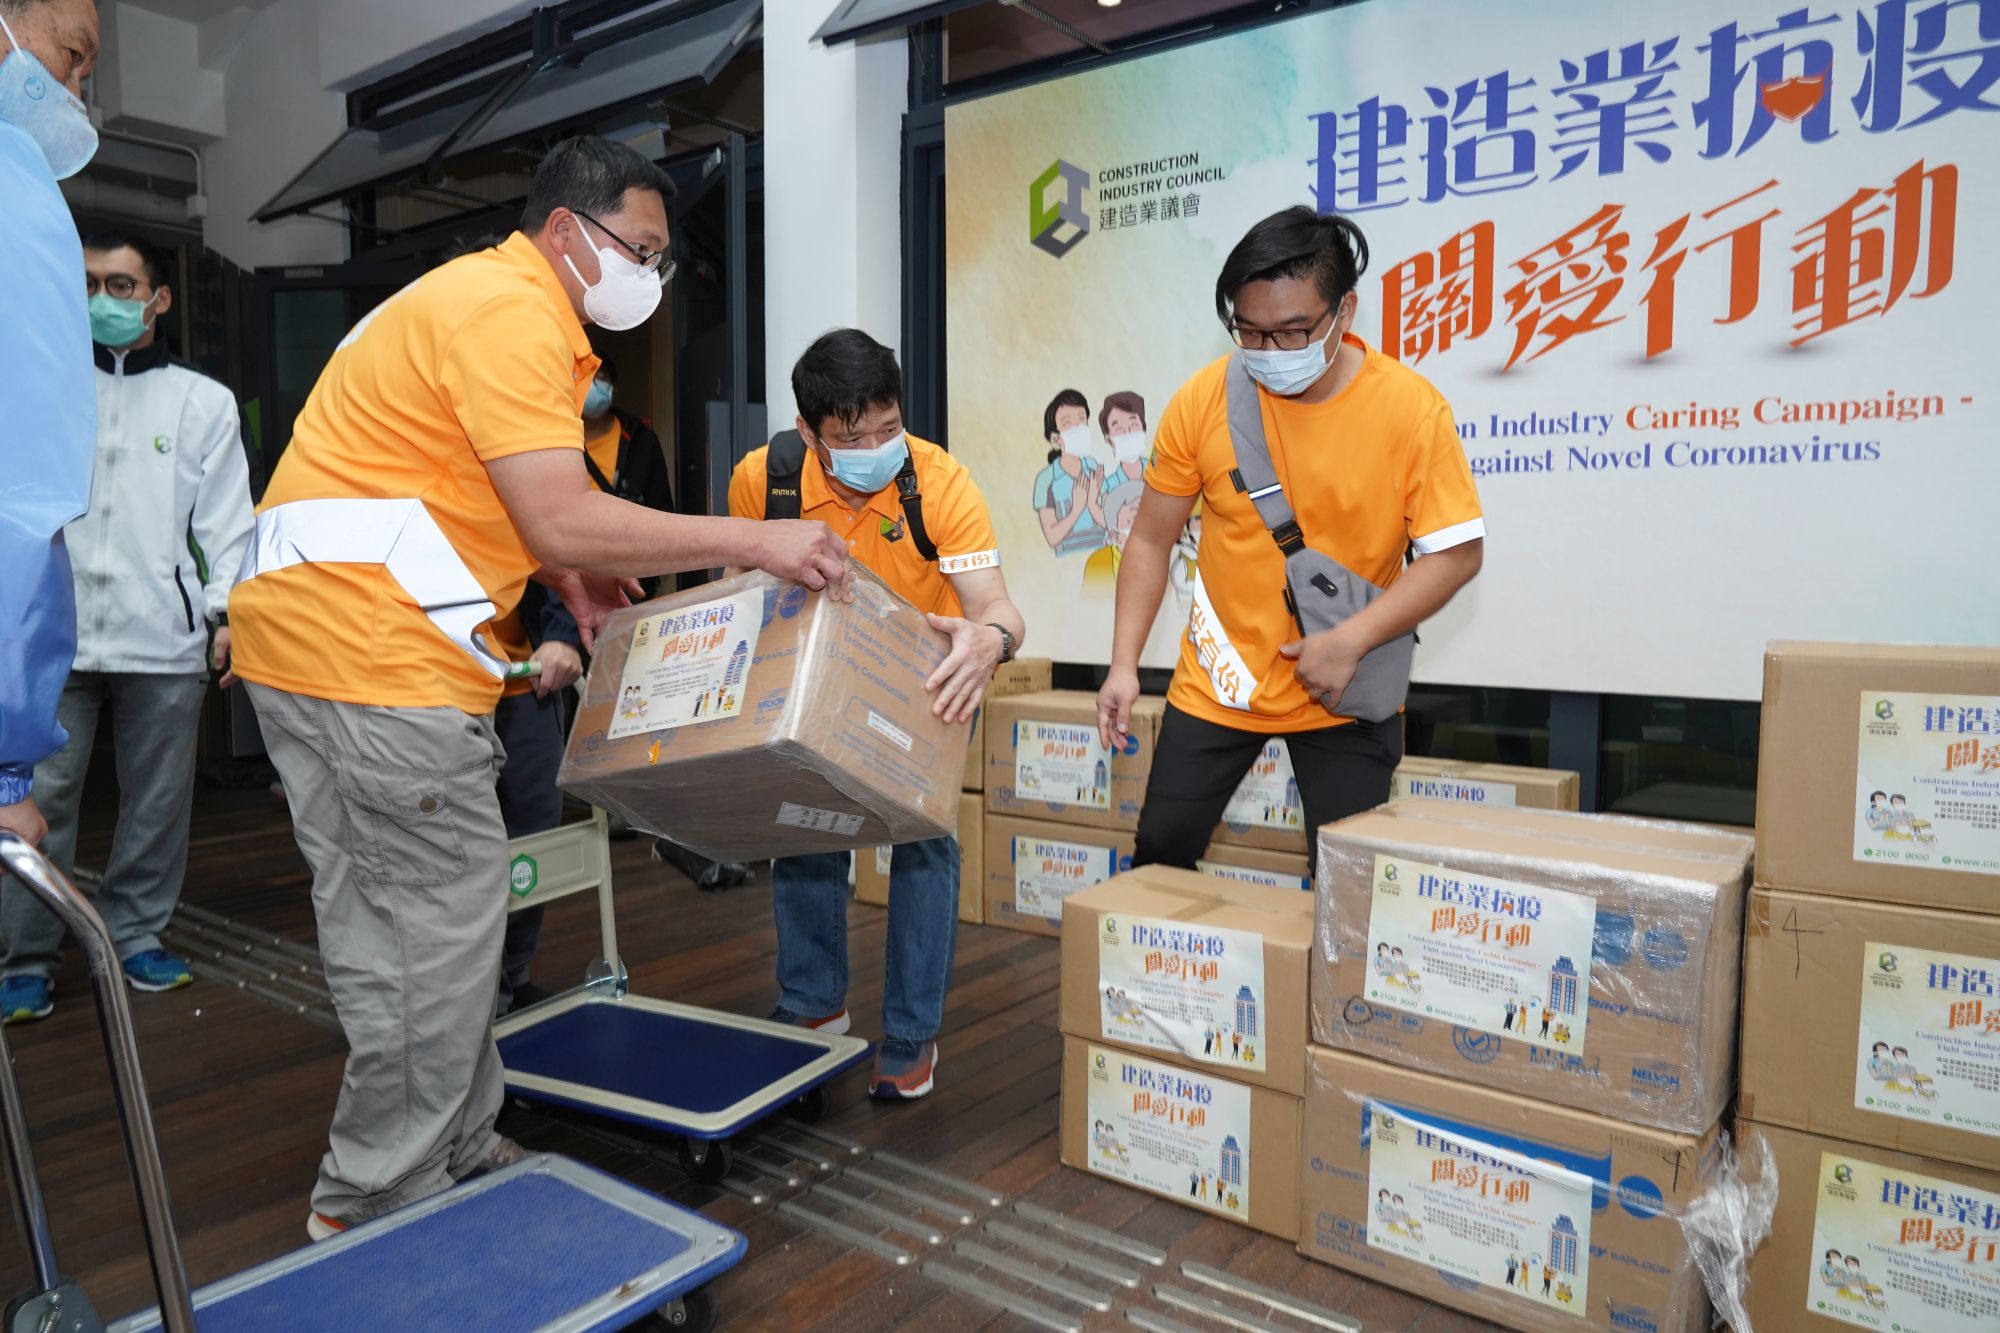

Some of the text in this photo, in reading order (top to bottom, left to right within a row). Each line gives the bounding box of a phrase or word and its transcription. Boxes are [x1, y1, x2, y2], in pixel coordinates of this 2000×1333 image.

[1307, 0, 2000, 215] 建造業抗疫
[1099, 153, 1199, 183] CONSTRUCTION
[1100, 167, 1225, 202] INDUSTRY COUNCIL
[1099, 192, 1200, 232] 建造業議會
[1381, 159, 1959, 373] 關愛行動
[1489, 411, 1614, 438] Industry
[1626, 401, 1740, 431] Caring
[1753, 390, 1944, 425] Campaign
[1568, 443, 1650, 471] Novel
[1664, 435, 1881, 468] Coronavirus
[1922, 705, 2000, 735] 建造
[1417, 873, 1543, 922] 建造業抗疫
[1132, 924, 1225, 957] 建造業抗疫
[1432, 907, 1531, 947] 關愛行動
[1781, 905, 1824, 979] 4
[1926, 962, 2000, 997] 建造
[1431, 1159, 1530, 1203] 關愛行動
